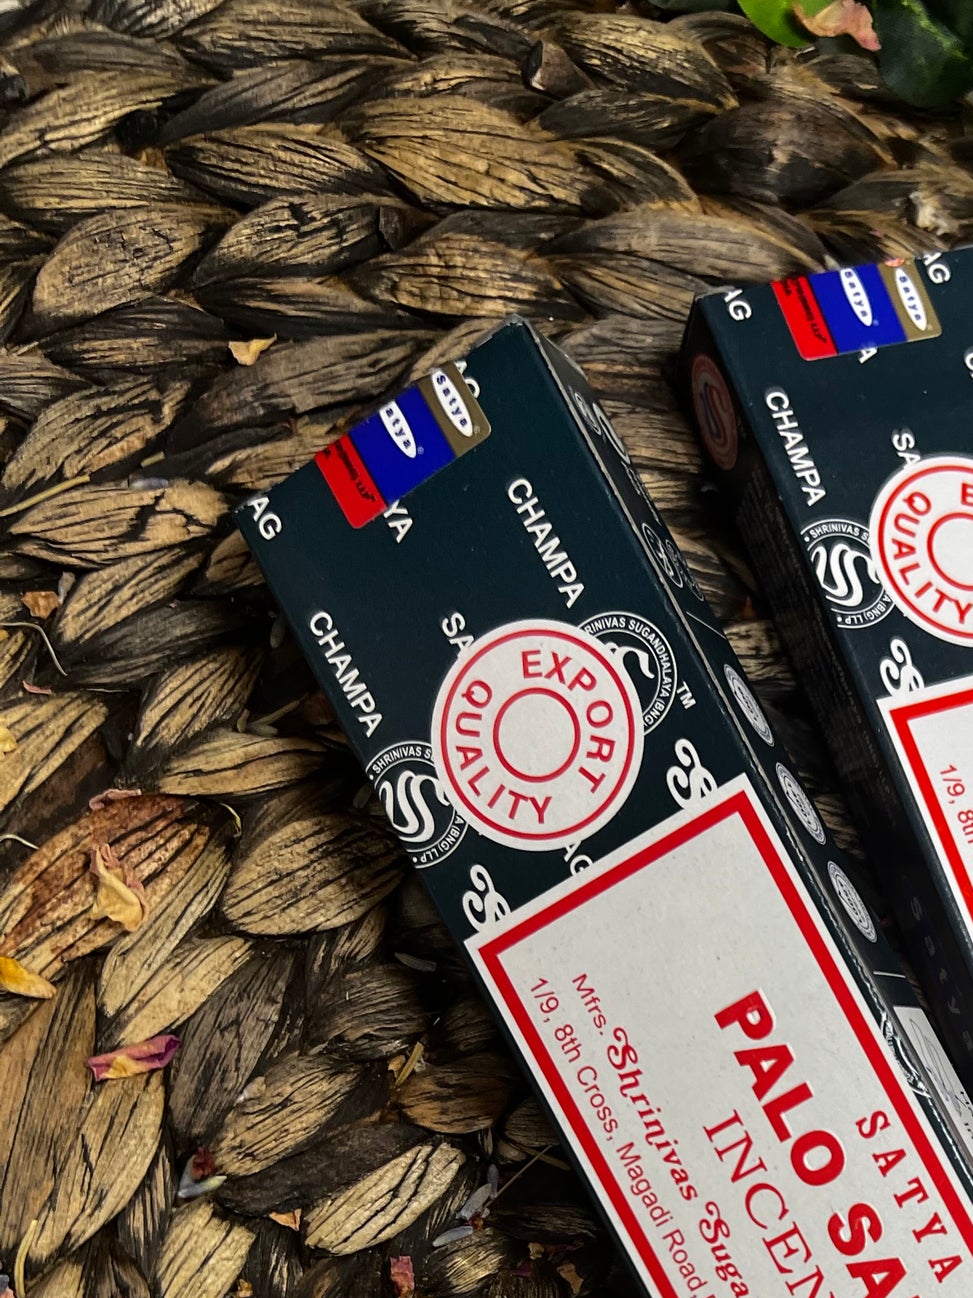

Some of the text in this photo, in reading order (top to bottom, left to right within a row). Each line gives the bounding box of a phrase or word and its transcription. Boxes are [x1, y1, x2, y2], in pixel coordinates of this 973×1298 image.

[385, 407, 412, 449] atya
[436, 374, 468, 427] Satya
[765, 391, 827, 506] CHAMPA
[507, 477, 586, 608] CHAMPA
[809, 523, 860, 539] SHRINIVAS
[892, 491, 973, 624] QUALITY
[309, 611, 384, 738] CHAMPA
[521, 650, 616, 793] EXPORT
[628, 619, 672, 698] SUGANDHALAYA
[372, 746, 422, 774] SHRINIVAS
[456, 679, 552, 824] QUALITY
[941, 764, 966, 804] 1/9,
[531, 978, 559, 1022] 1/9,
[554, 1024, 581, 1062] 8th
[576, 1065, 618, 1140] Cross,
[616, 1141, 685, 1249] Magadi
[572, 973, 620, 1035] Mfrs.
[606, 1027, 698, 1201] Shrinivas
[714, 990, 845, 1187] PALO
[855, 1109, 963, 1283] SATYA
